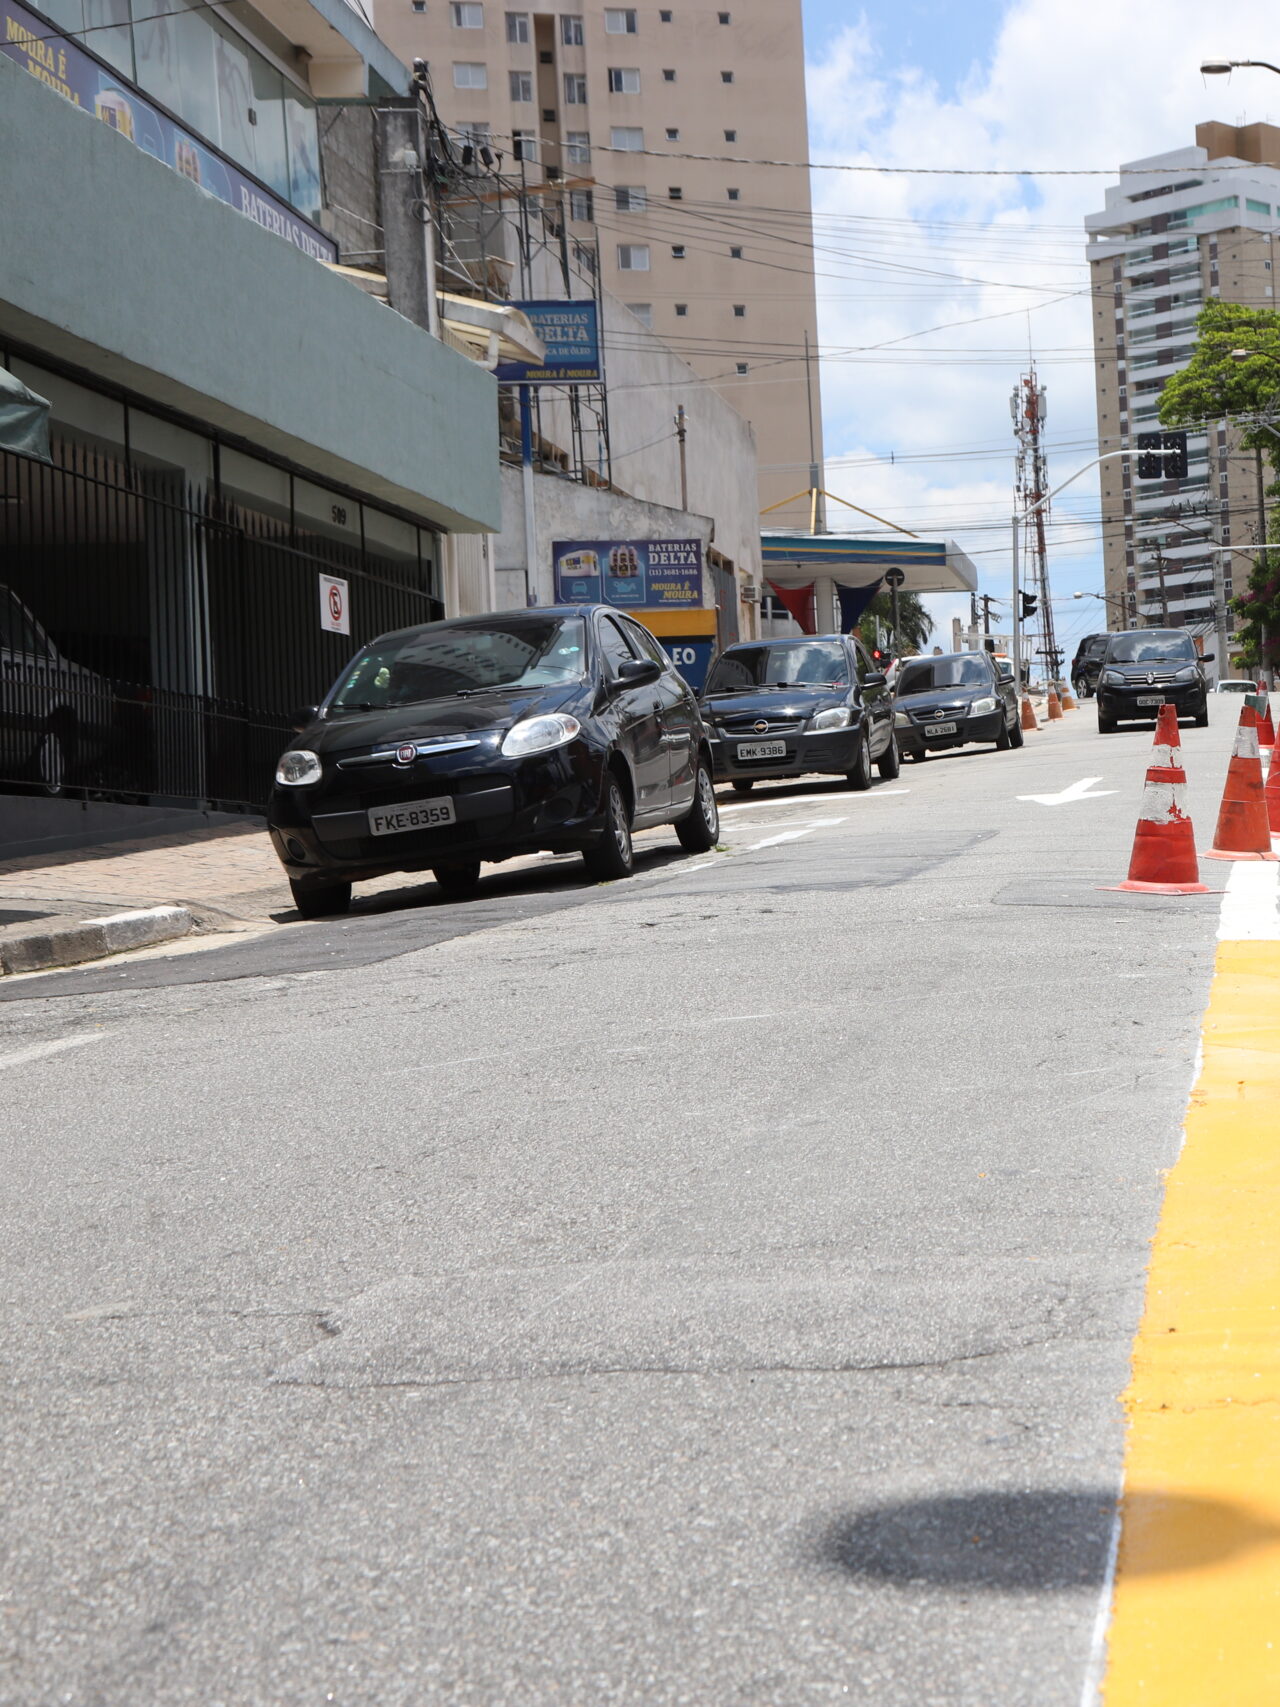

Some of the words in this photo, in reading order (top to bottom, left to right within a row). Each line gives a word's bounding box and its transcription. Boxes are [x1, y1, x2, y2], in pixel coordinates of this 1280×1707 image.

[6, 15, 55, 72] MOURA
[240, 184, 300, 248] BATERIAS
[648, 543, 697, 551] BATERIAS
[648, 552, 697, 565] DELTA
[651, 583, 682, 591] MOURA
[664, 590, 698, 599] MOURA
[400, 748, 412, 759] FIAT
